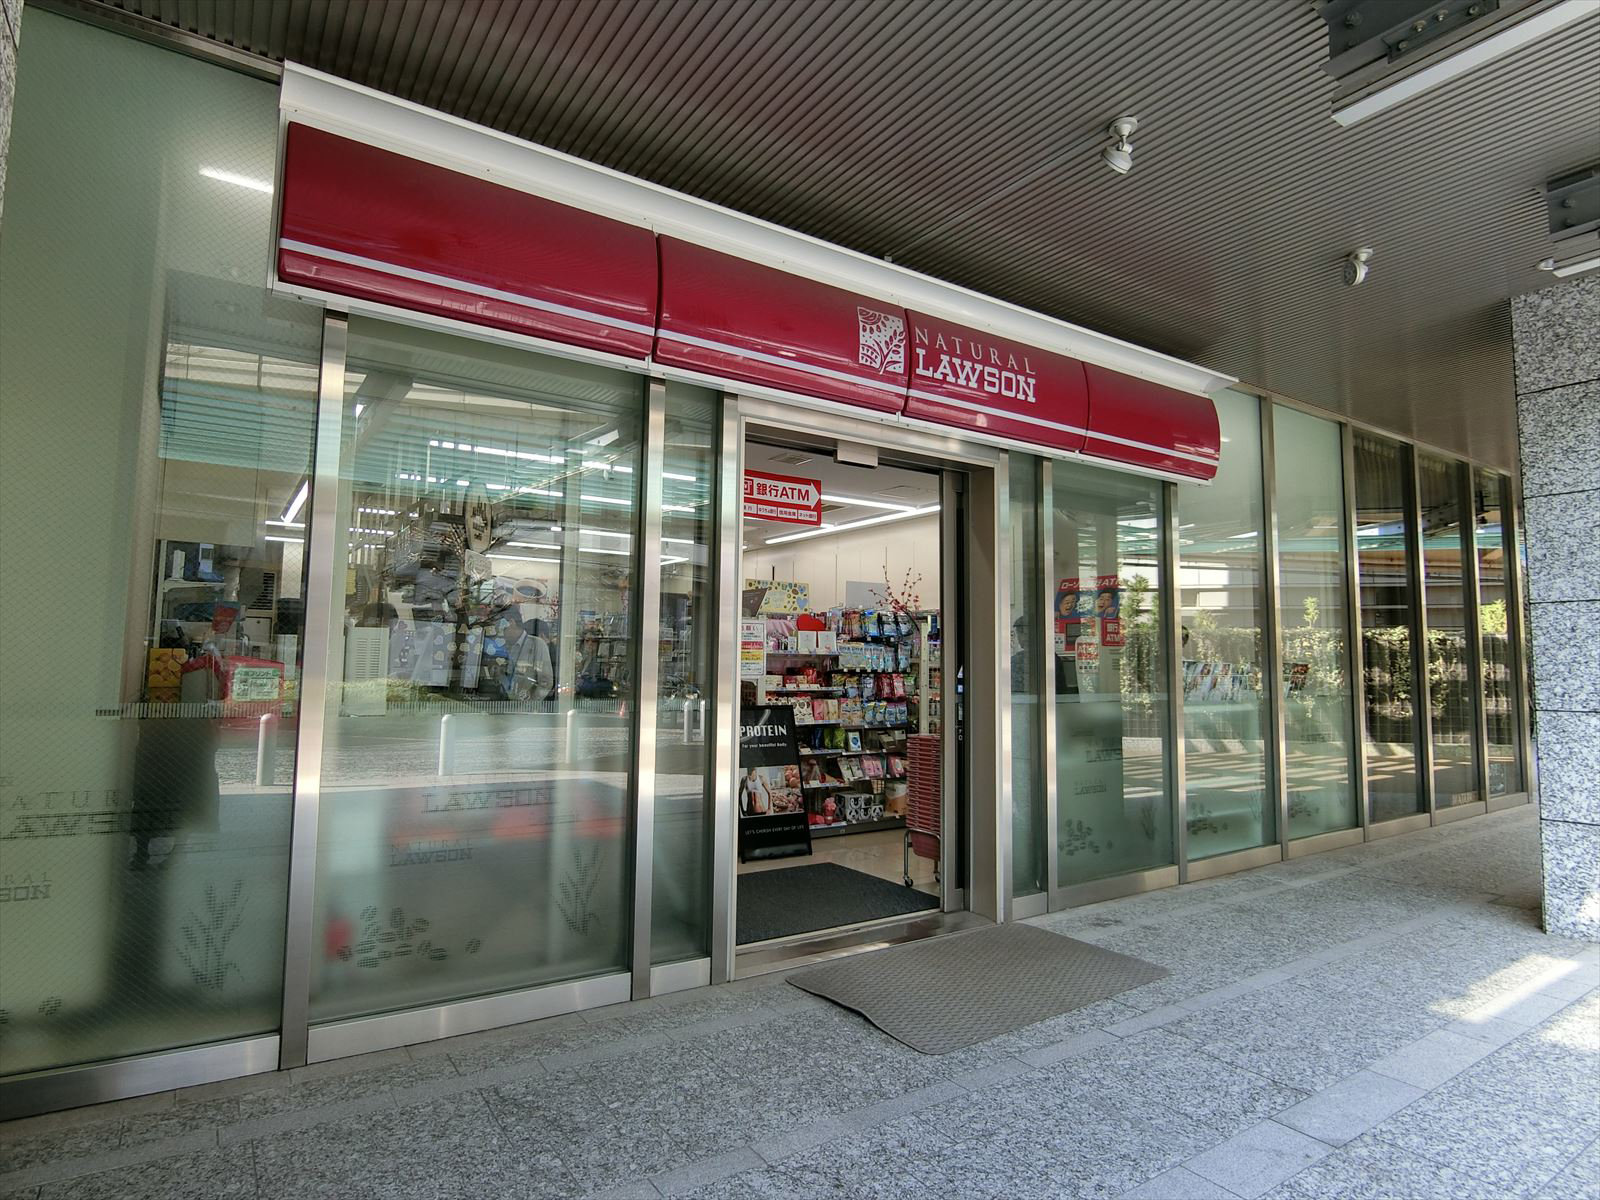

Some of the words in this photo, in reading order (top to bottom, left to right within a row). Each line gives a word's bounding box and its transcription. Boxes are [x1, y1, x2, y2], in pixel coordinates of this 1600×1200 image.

[914, 325, 1037, 376] NATURAL
[914, 347, 1037, 404] LAWSON
[756, 482, 810, 502] 銀行ATM
[740, 724, 788, 737] PROTEIN
